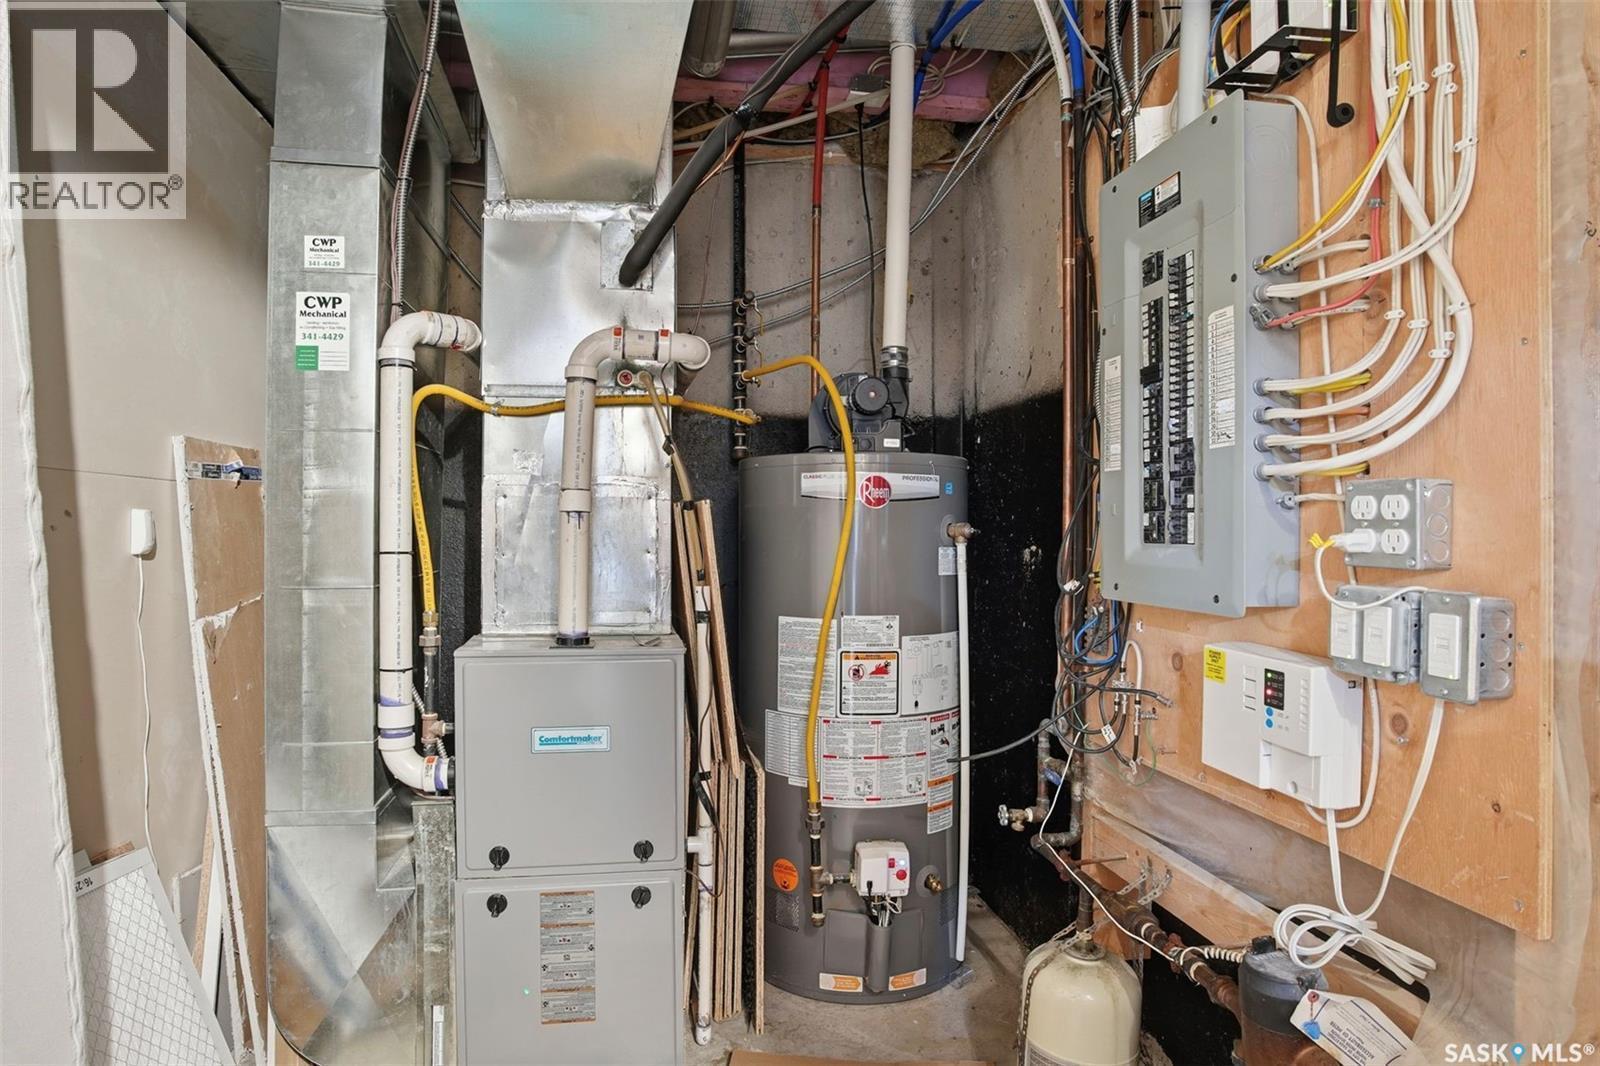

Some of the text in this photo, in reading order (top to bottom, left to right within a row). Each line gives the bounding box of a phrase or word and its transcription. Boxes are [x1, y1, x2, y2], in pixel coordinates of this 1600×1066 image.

[312, 238, 337, 247] CWP
[304, 296, 342, 309] CWP
[299, 310, 347, 318] Mechanical
[302, 333, 344, 341] 341-4429
[862, 475, 890, 504] Rheem
[539, 734, 602, 743] Comfortmaker
